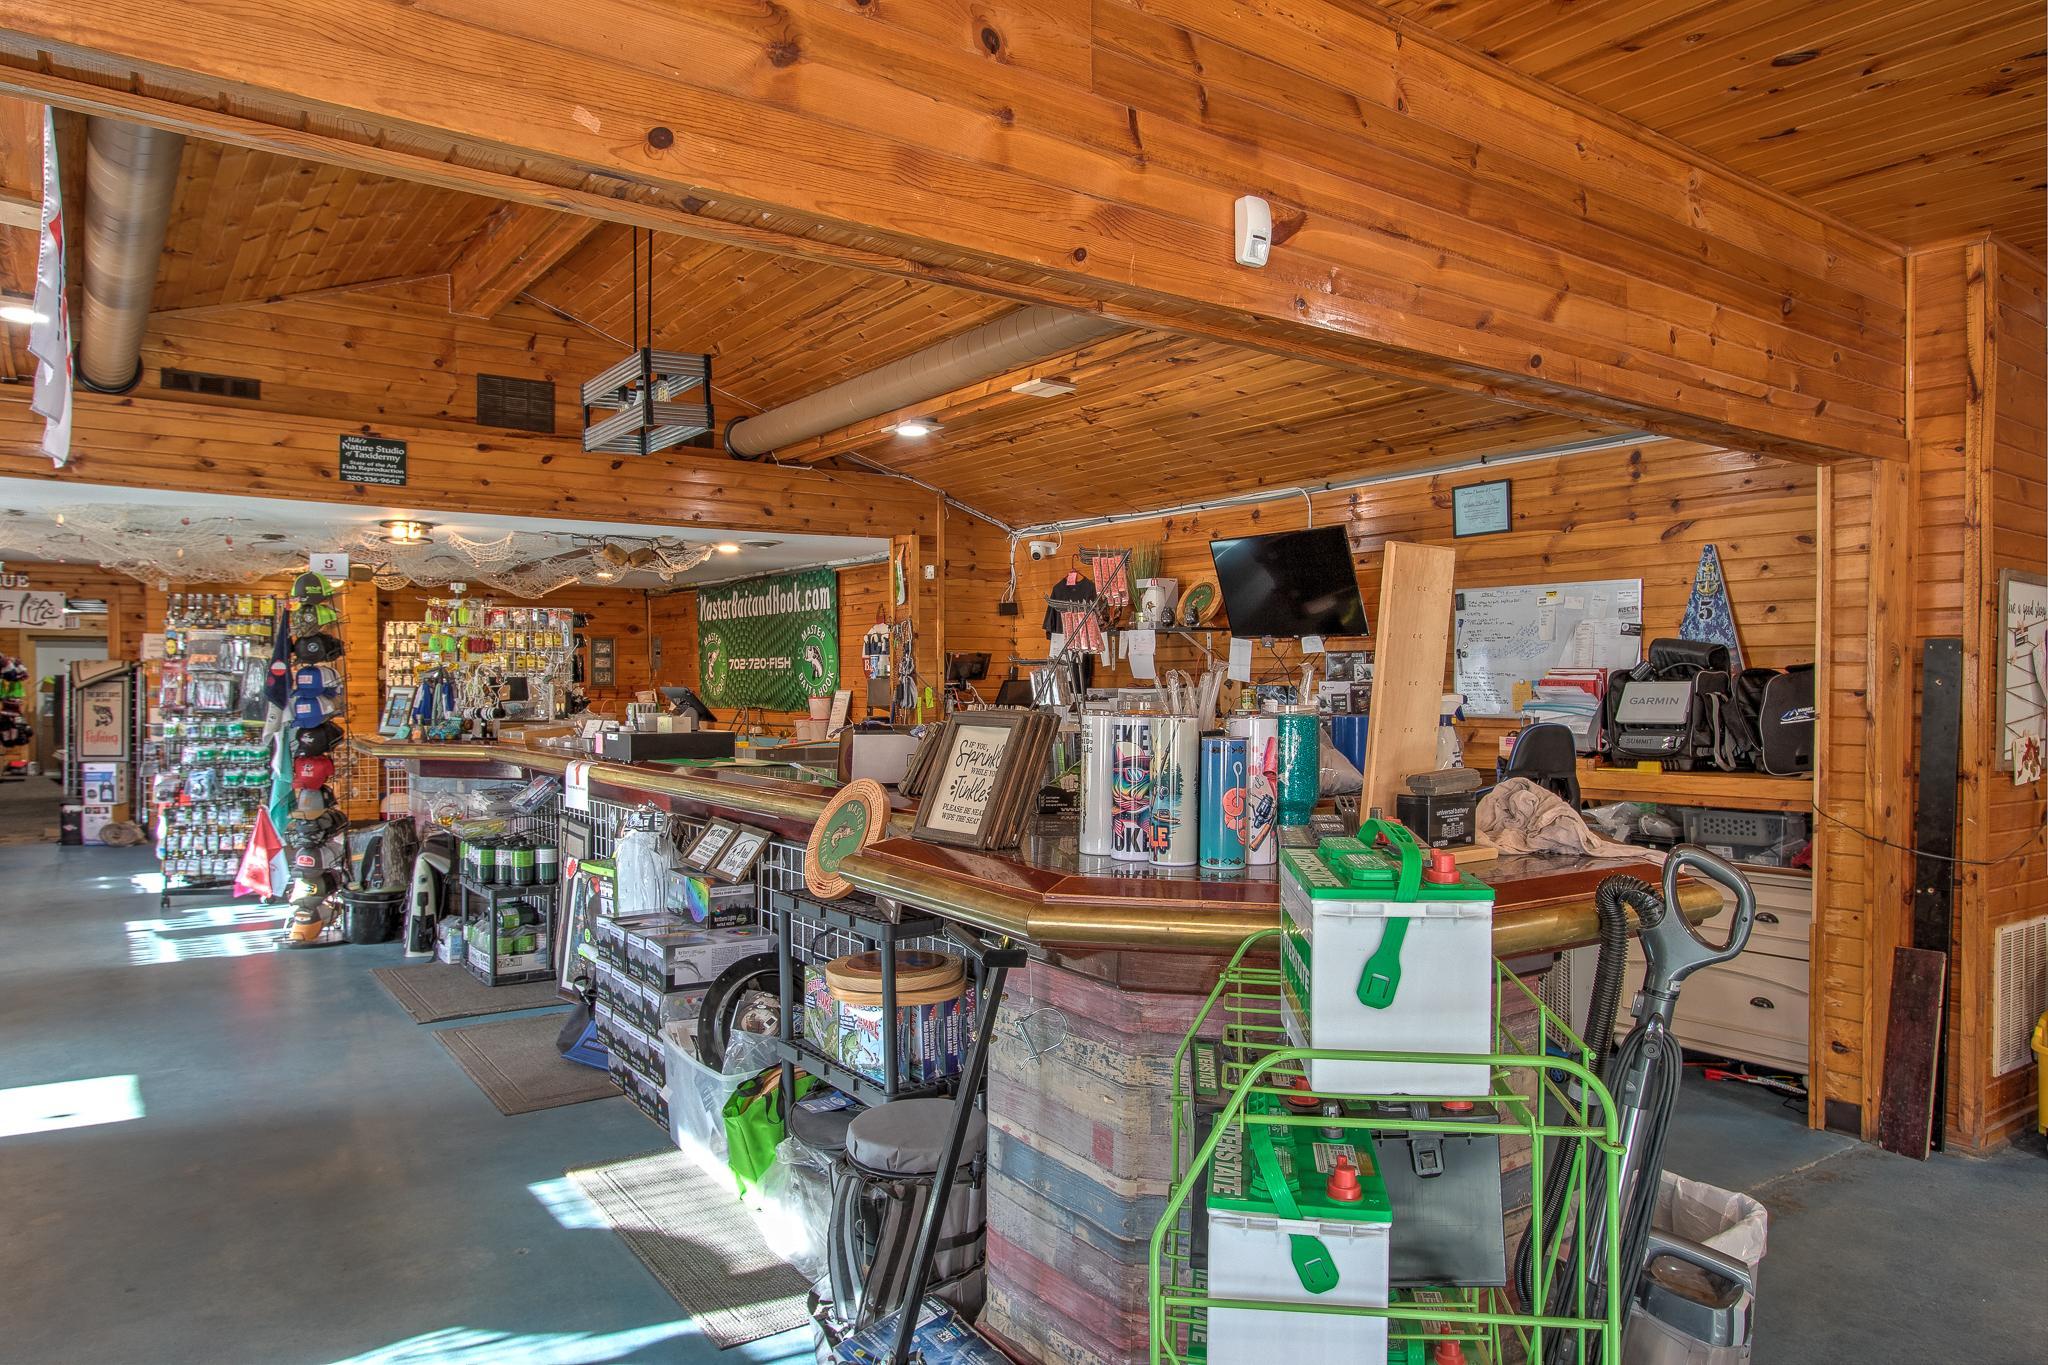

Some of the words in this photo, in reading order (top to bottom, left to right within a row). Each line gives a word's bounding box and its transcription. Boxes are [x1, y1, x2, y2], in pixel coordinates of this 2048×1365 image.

[342, 442, 374, 451] Nature
[376, 445, 405, 455] Studio
[354, 450, 400, 463] Taxidermy
[1698, 600, 1714, 620] 5
[2023, 600, 2033, 621] good
[801, 624, 826, 642] MASTER
[728, 657, 791, 670] 702-720-FISH
[798, 672, 812, 695] BAIT
[818, 670, 835, 697] HOOK
[1629, 697, 1679, 705] GARMIN
[976, 742, 989, 752] YOU,
[955, 740, 1005, 771] Sprinkl
[971, 767, 988, 776] WHILE
[953, 775, 986, 802] Tinkle
[847, 803, 863, 831] MASTER
[942, 803, 964, 813] PLEASE
[971, 809, 983, 817] NEA
[1436, 808, 1455, 816] universal
[942, 812, 955, 821] WIPE
[956, 815, 966, 823] THE
[966, 816, 980, 825] SEAT
[822, 831, 832, 855] BAIT
[825, 859, 840, 869] HOO
[1198, 1048, 1217, 1090] INTERSTATE
[1213, 1121, 1243, 1197] NTERSTATE
